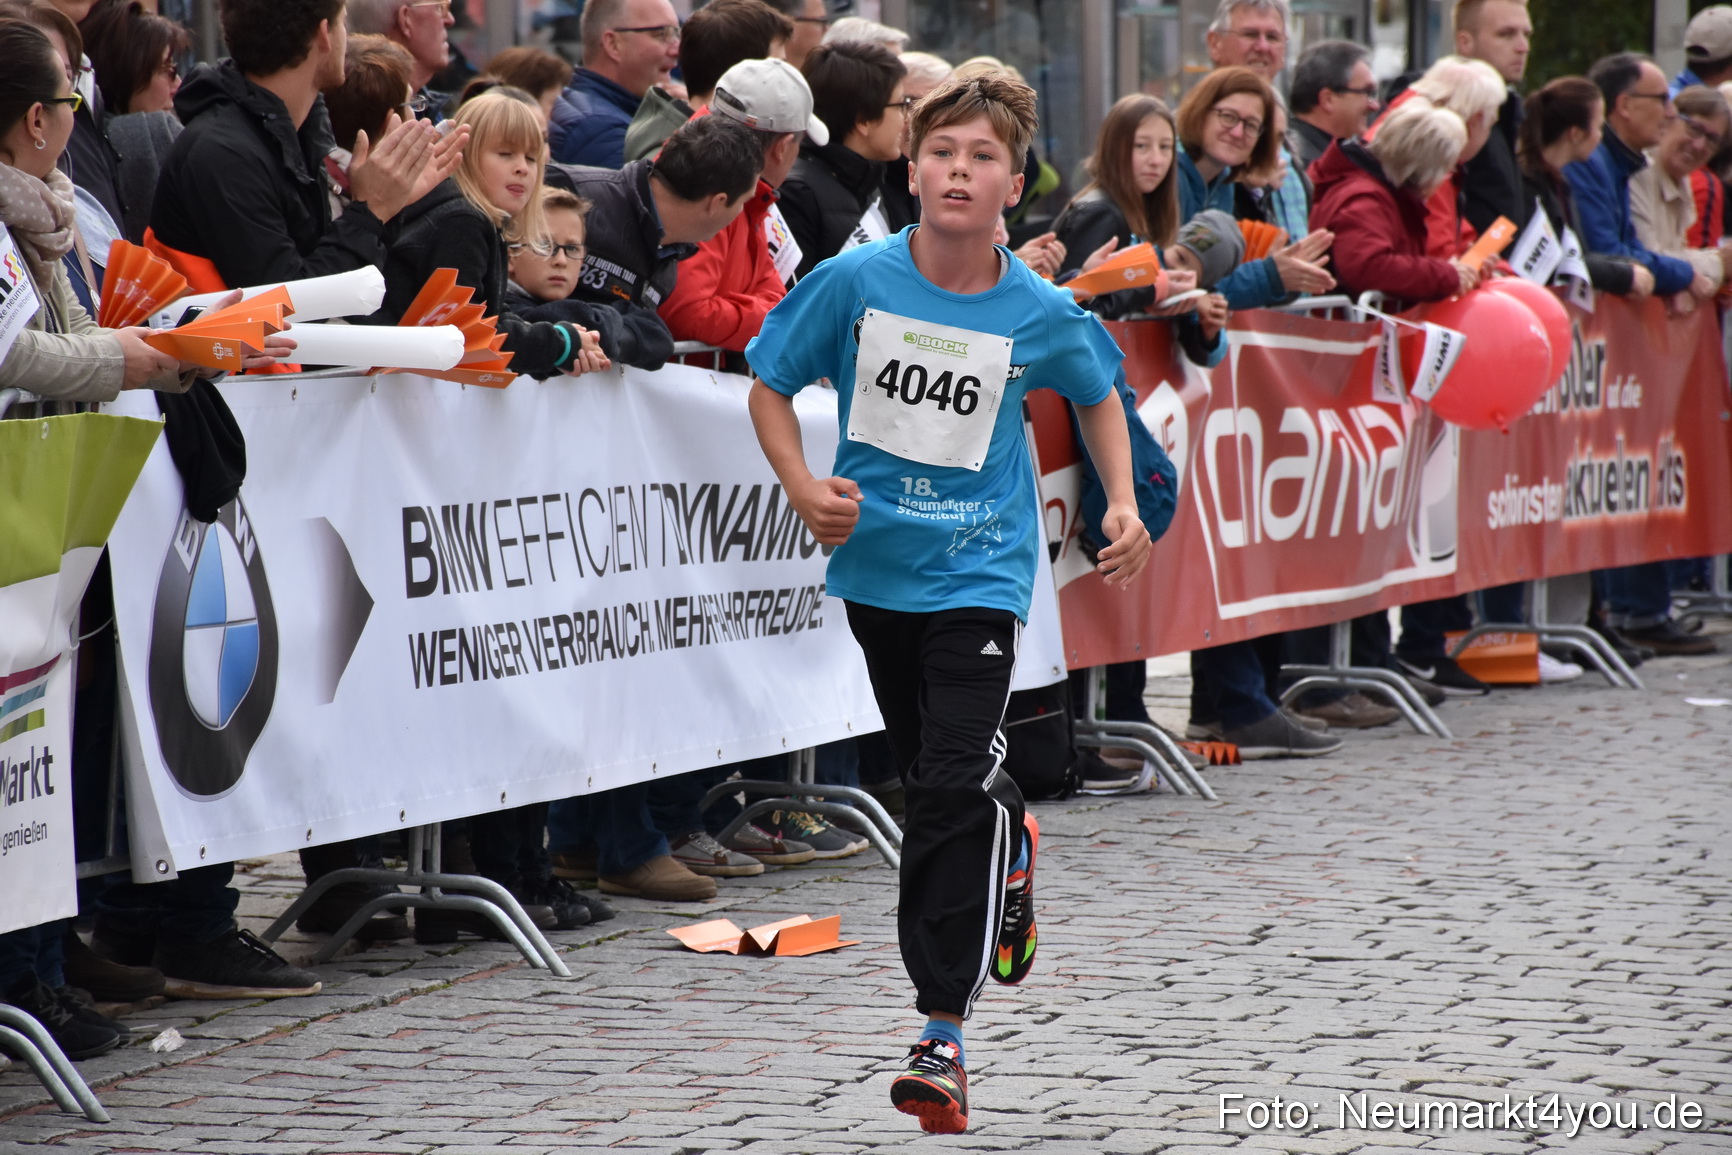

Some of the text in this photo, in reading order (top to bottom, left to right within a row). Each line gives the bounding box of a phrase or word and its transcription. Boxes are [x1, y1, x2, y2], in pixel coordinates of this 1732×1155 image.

[918, 334, 969, 355] BOCK
[863, 385, 868, 393] J
[875, 358, 982, 416] 4046
[900, 477, 938, 498] 18.
[898, 497, 981, 513] Neumarkter
[956, 525, 986, 550] September
[402, 502, 493, 599] BMW
[408, 583, 826, 689] WENIGER VERBRAUCH. MEHR FAHRFREUDE.
